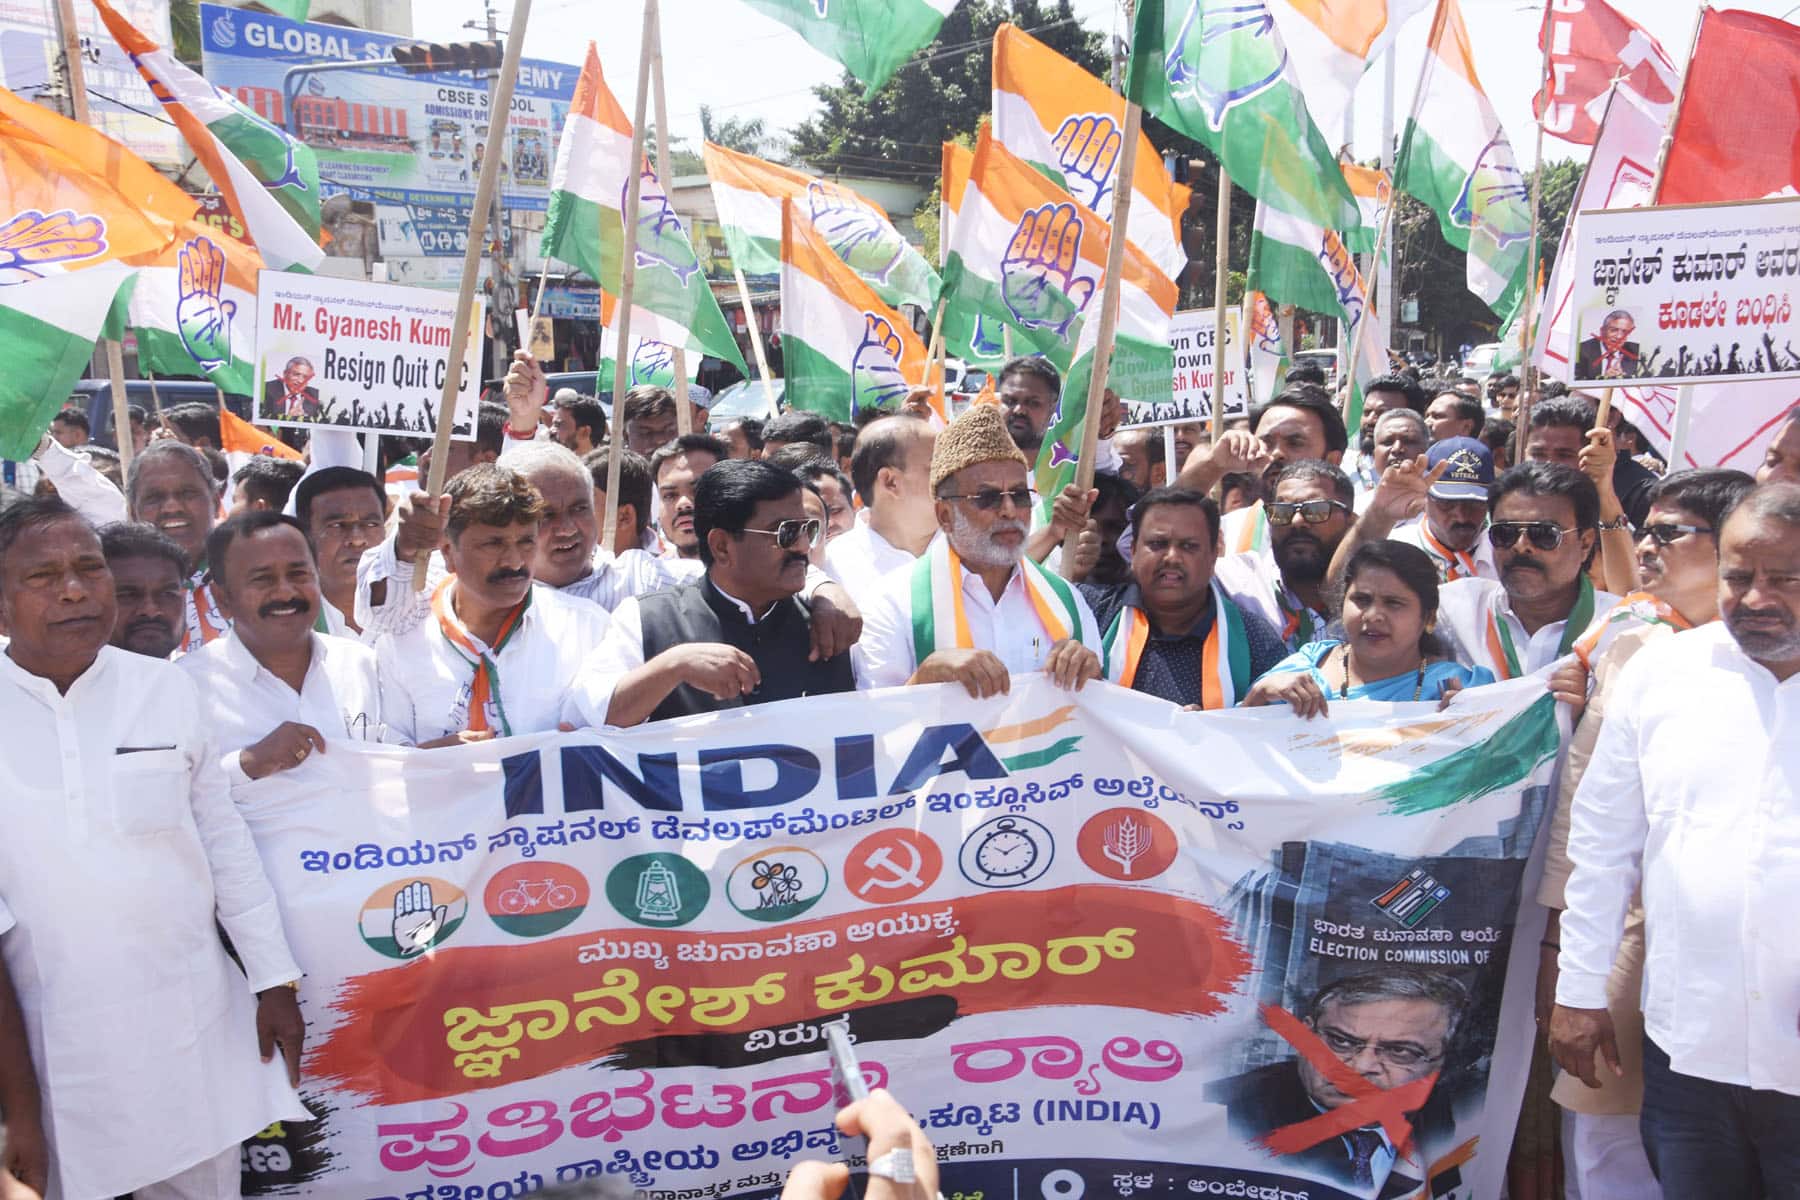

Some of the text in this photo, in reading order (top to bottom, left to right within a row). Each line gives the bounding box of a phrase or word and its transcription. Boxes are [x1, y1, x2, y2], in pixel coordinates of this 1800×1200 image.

[244, 22, 357, 61] GLOBAL
[437, 88, 535, 113] CBSE SOOL
[474, 108, 489, 121] OPE
[1672, 242, 1747, 282] ಕುಮಾರ್
[1756, 244, 1800, 277] ಅವರ
[273, 303, 305, 332] Mr.
[315, 307, 401, 341] Gyanesh
[1658, 291, 1727, 330] ಕೂಡಲೇ
[324, 348, 468, 392] Resign Quit CC
[502, 722, 1009, 820] INDIA
[300, 833, 477, 874] ಇಂಡಿಯನ್
[926, 773, 1084, 814] ಇಂಕ್ಲೂಸಿವ್
[1313, 918, 1366, 940] ಭಾರತ
[578, 938, 669, 970] ಮುಖ್ಯ
[677, 930, 837, 962] ಚುನಾವಣಾ
[1310, 938, 1490, 965] ELECTION COMMISSION OF
[443, 926, 1137, 1079] ಜ್ಞಾನೇಶ್ ಕುಮಾರ್
[1033, 1099, 1161, 1130] (INDIA)
[736, 1171, 783, 1187] ಮತ್ತು
[934, 1139, 1004, 1161] ಕ್ಷಣೆಗಾಗಿ
[1112, 1171, 1154, 1197] ಸ್ಥಳ
